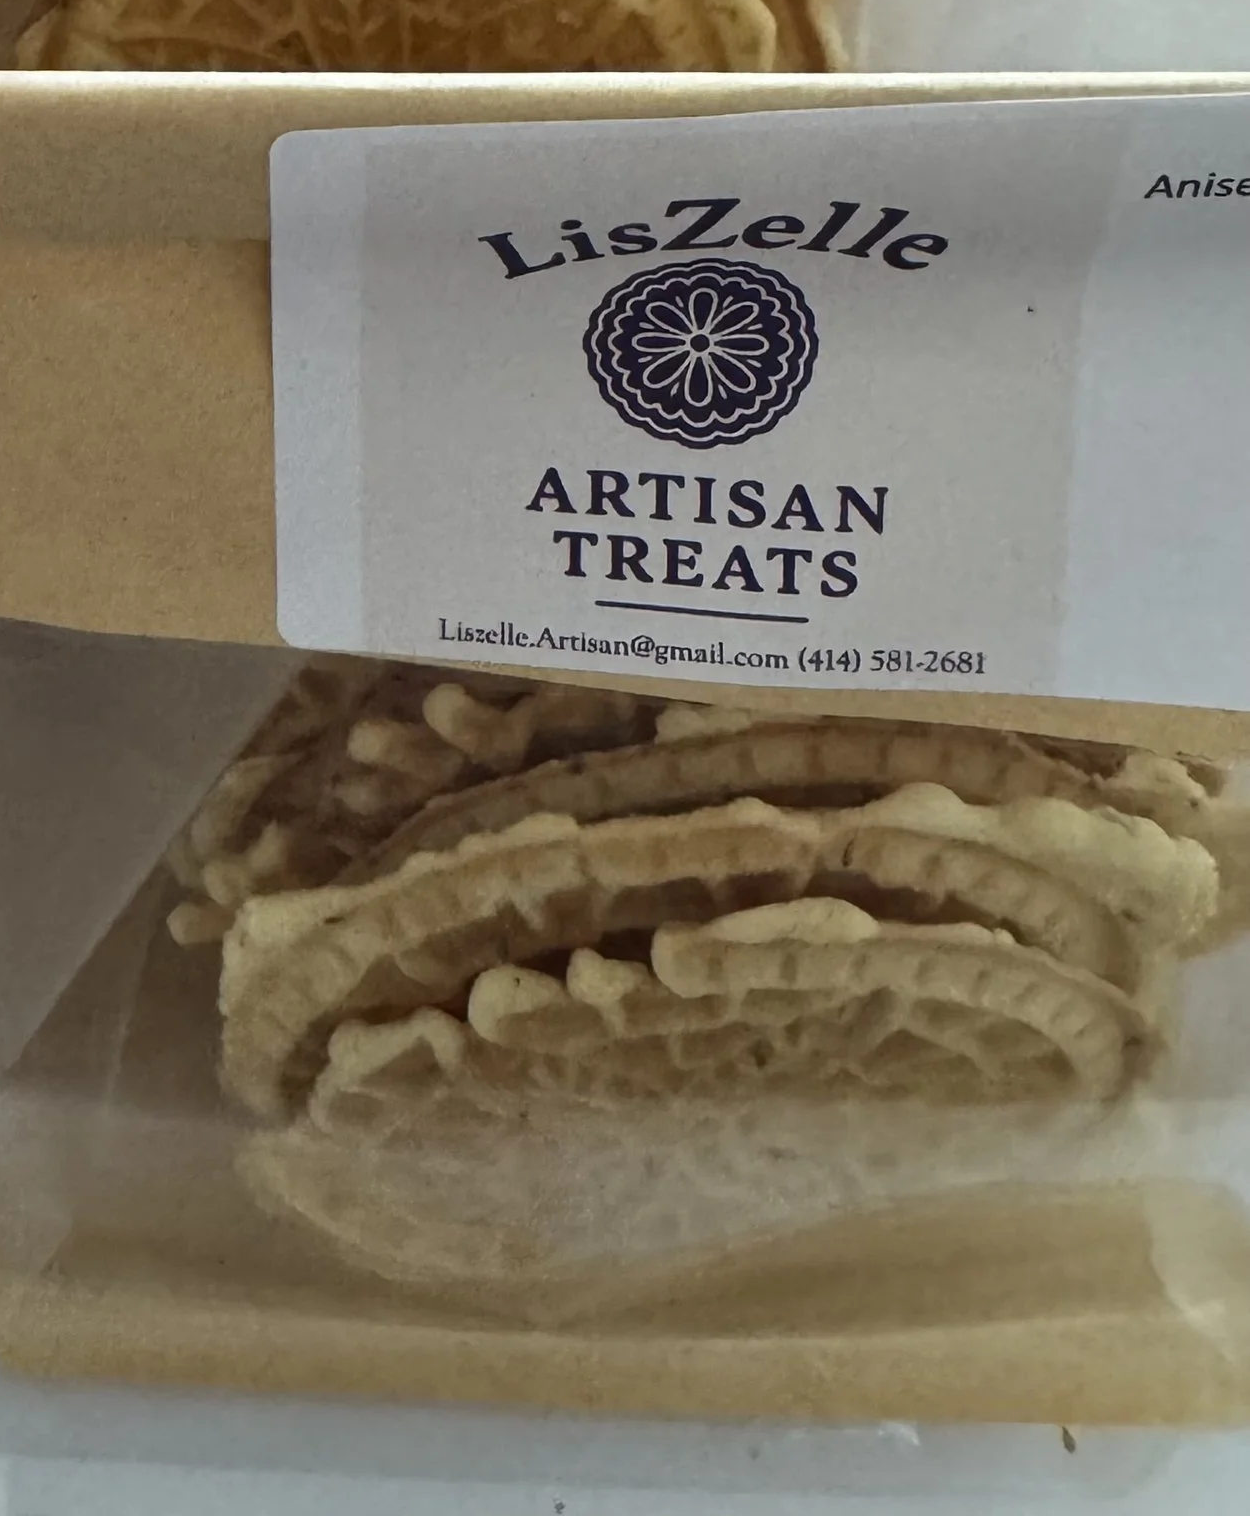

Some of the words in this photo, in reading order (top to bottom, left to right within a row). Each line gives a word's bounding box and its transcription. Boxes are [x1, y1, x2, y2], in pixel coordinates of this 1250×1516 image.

[478, 198, 948, 279] LisZelle
[526, 467, 889, 535] ARTISAN
[553, 530, 858, 597] TREATS
[799, 647, 860, 672] (414)
[870, 650, 984, 674] 581-2681
